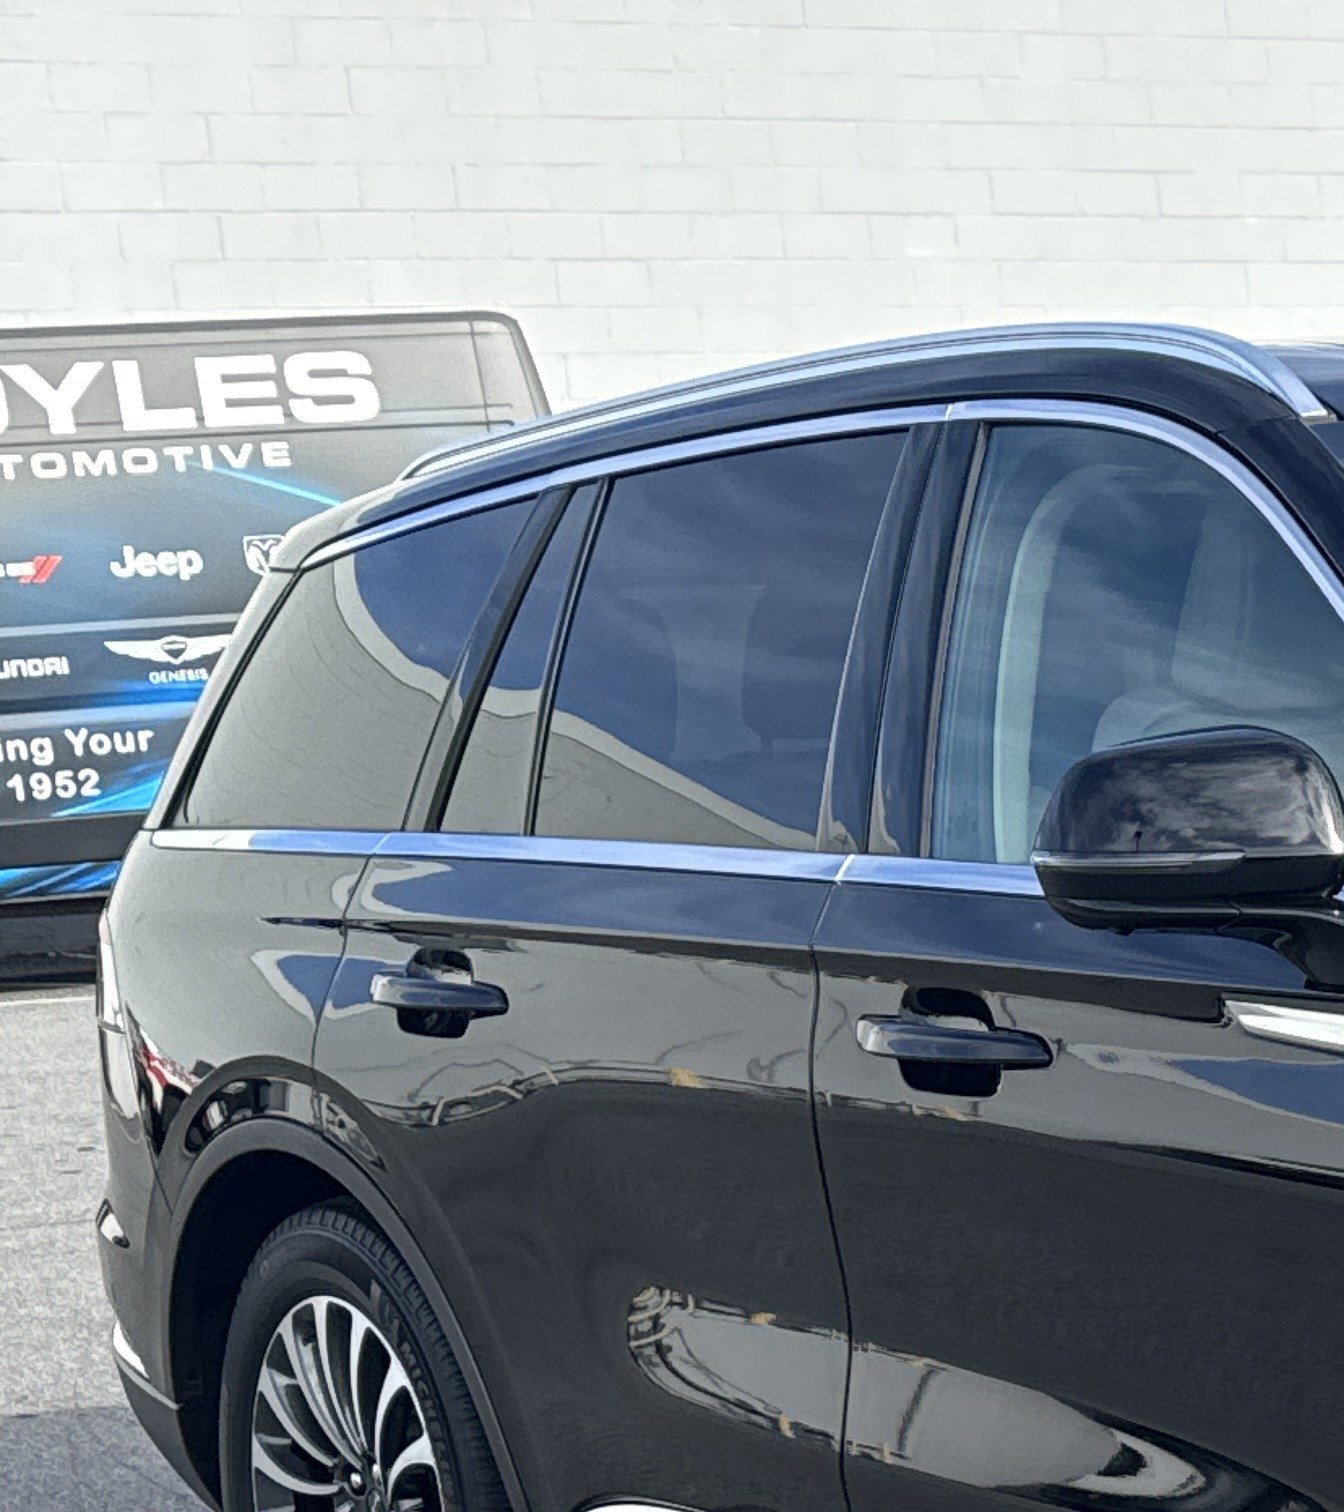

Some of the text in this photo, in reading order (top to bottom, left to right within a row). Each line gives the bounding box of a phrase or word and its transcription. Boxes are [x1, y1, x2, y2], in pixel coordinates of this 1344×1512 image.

[109, 545, 203, 580] Jeep
[64, 727, 154, 757] Your
[6, 768, 101, 802] 1952
